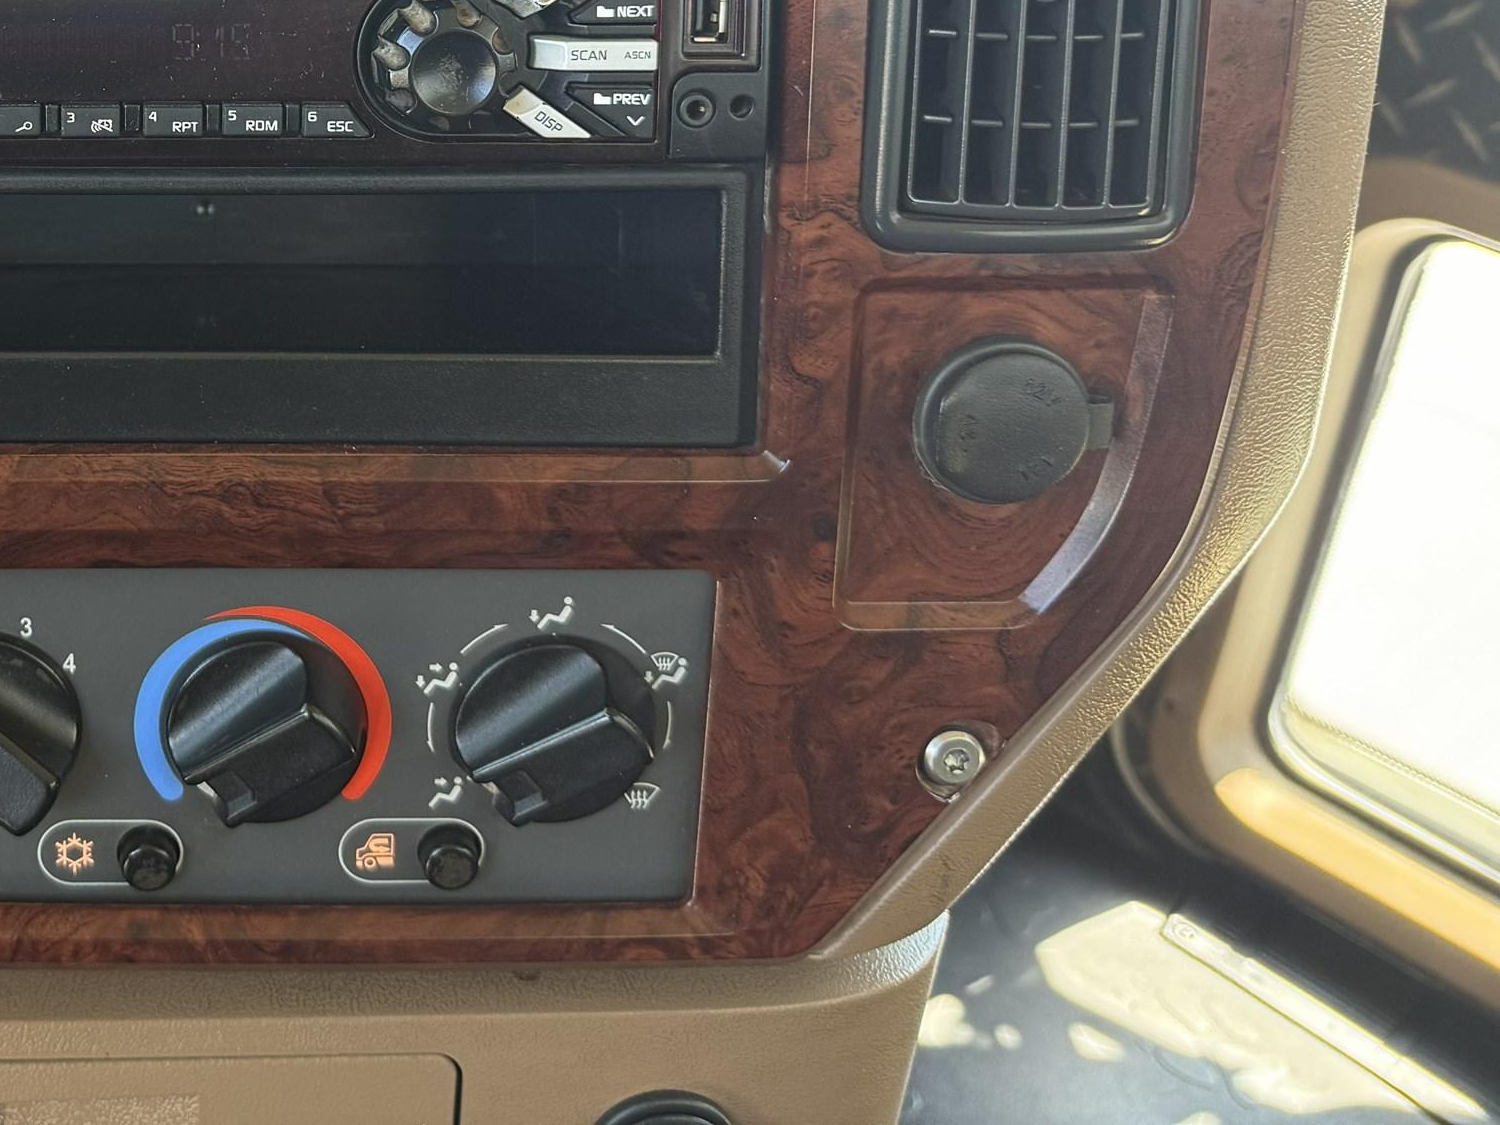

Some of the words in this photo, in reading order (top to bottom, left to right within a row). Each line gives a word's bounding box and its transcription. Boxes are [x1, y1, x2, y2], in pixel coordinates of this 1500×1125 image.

[617, 5, 655, 17] NEXT
[571, 49, 607, 61] SCAN
[624, 50, 651, 60] ASCN
[613, 93, 651, 106] PREV
[66, 112, 76, 123] 3
[148, 111, 157, 122] 4
[227, 110, 237, 121] 5
[307, 111, 318, 122] 6
[534, 110, 563, 133] DISP
[172, 121, 198, 133] RPT
[245, 120, 278, 132] RDM
[327, 121, 354, 132] ESC
[20, 617, 33, 637] 3
[62, 653, 77, 674] 4
